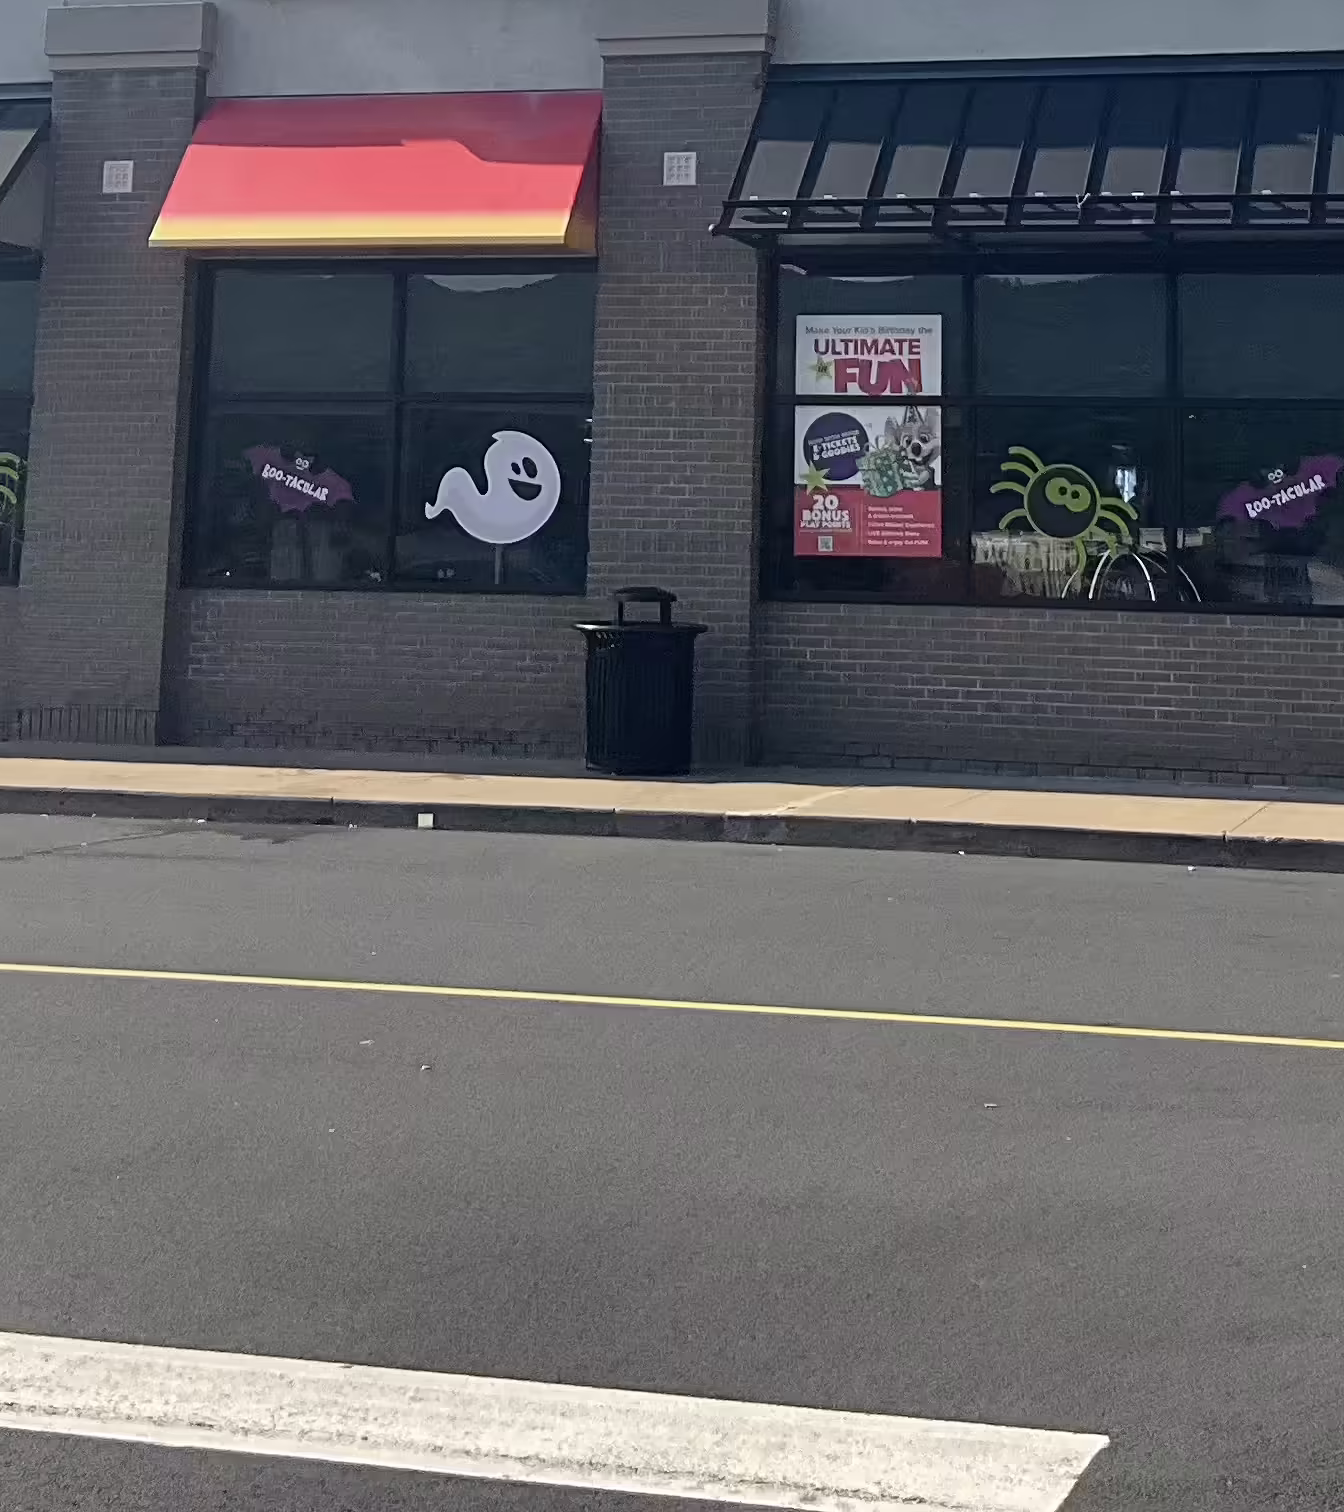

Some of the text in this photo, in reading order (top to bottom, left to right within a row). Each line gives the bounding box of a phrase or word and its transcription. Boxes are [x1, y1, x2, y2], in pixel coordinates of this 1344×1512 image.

[832, 326, 851, 335] Your
[918, 326, 933, 334] the
[814, 338, 921, 356] ULTIMATE
[834, 357, 923, 396] FUN
[261, 464, 329, 501] BOO-TACULAR
[812, 494, 840, 510] 20
[1245, 474, 1326, 518] BOO-TACULAR
[802, 509, 850, 521] BONUS
